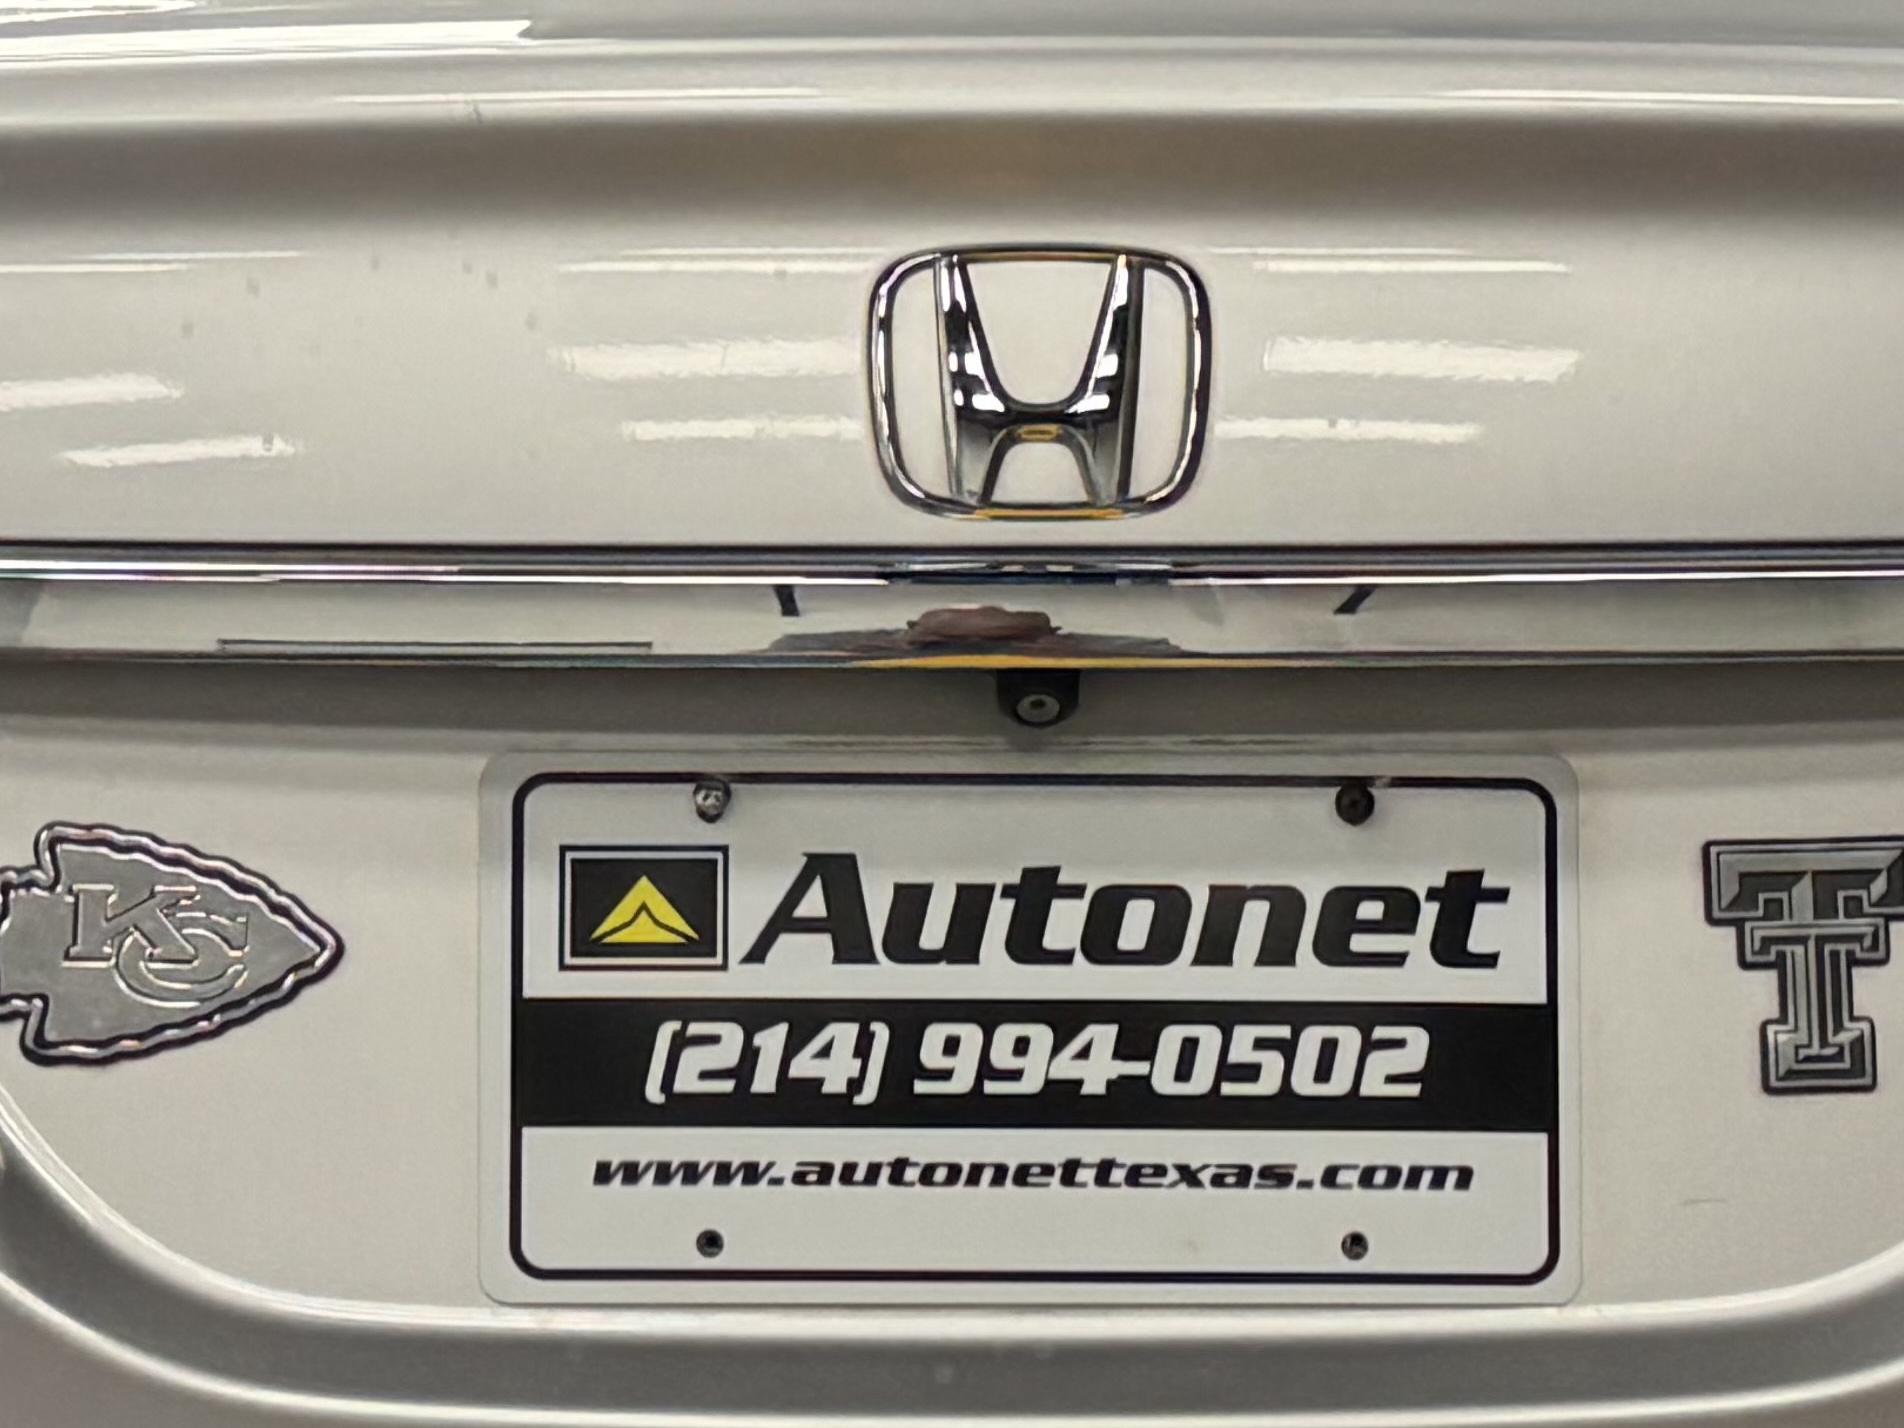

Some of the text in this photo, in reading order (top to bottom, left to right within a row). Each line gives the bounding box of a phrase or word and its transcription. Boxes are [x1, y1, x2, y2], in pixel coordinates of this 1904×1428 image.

[62, 882, 250, 1009] KC
[738, 851, 1511, 970] Autonet
[645, 1020, 1432, 1105] (214) 994-0502
[592, 1155, 1475, 1193] www.autonettexas.com
